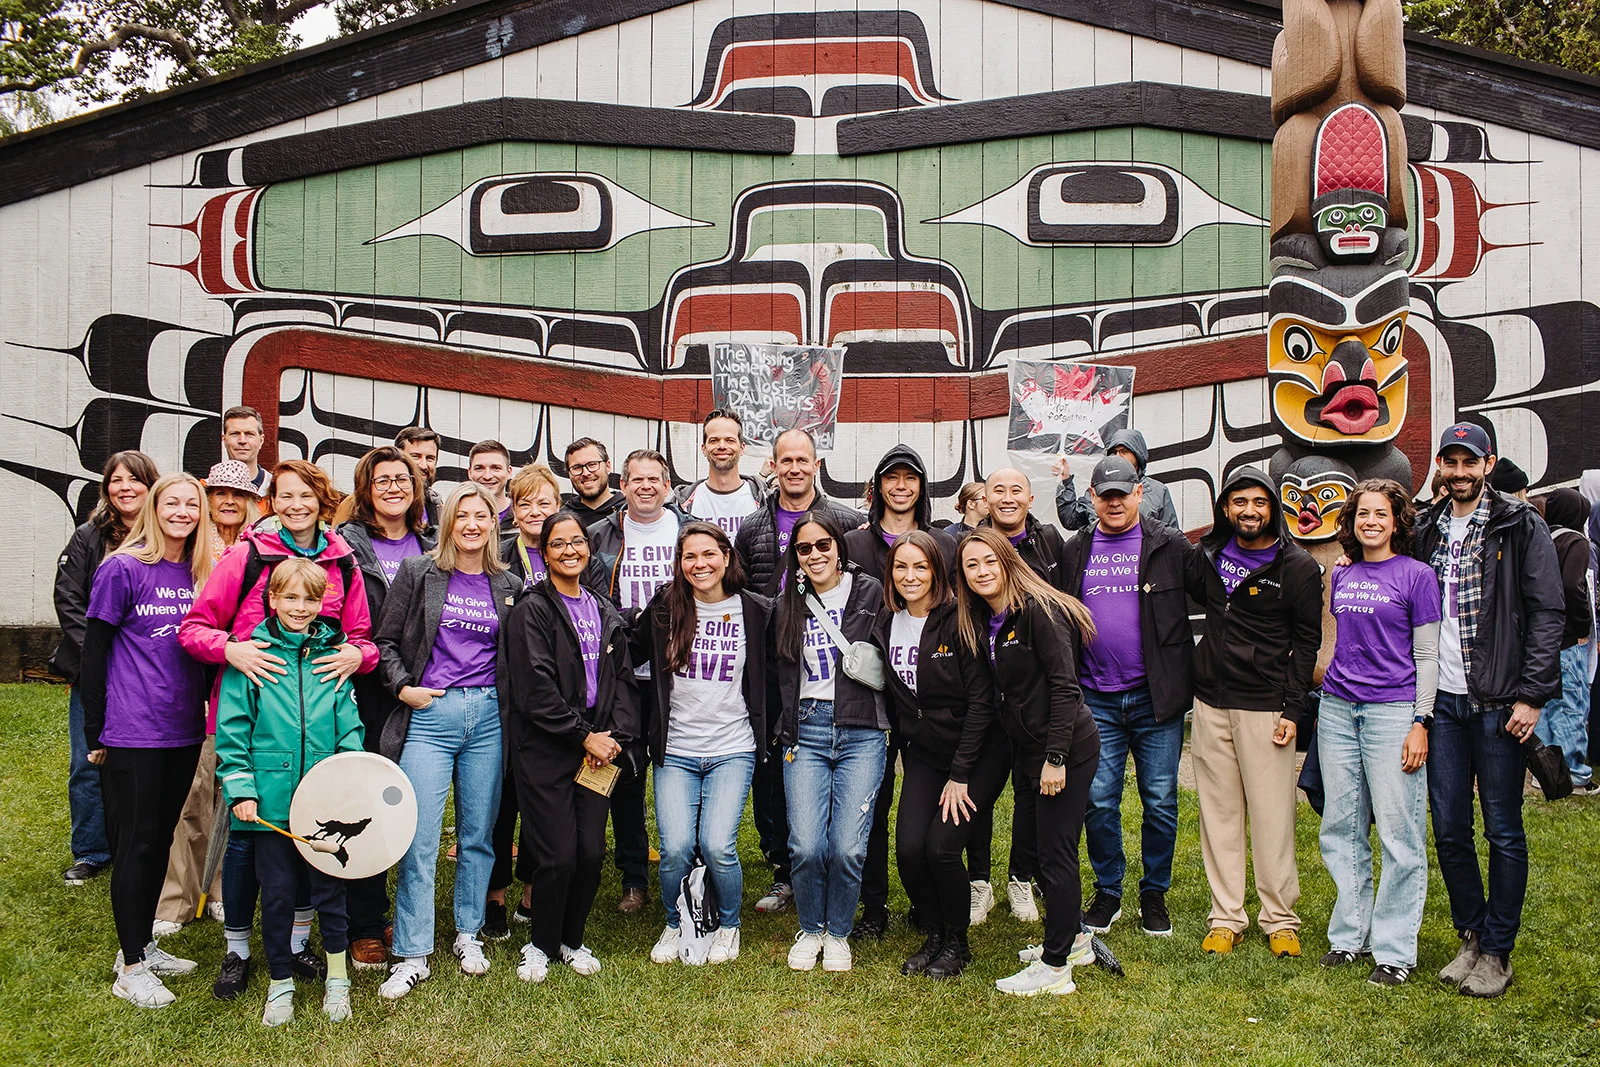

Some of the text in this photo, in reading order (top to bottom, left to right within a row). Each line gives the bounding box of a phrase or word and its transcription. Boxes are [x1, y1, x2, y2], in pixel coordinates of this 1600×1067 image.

[715, 344, 795, 373] The Missing
[715, 373, 750, 389] The
[735, 405, 767, 421] The
[718, 516, 744, 533] GIV
[643, 545, 673, 561] GIV
[1090, 553, 1138, 564] We Give
[382, 559, 400, 570] We
[622, 565, 659, 577] HERE
[1221, 559, 1236, 574] We
[1083, 567, 1108, 577] here
[1110, 566, 1130, 576] We
[1106, 584, 1139, 593] TELUS
[1347, 581, 1379, 591] We Give
[155, 587, 197, 600] We Giv
[1356, 591, 1370, 600] We
[1369, 592, 1390, 603] Live
[447, 594, 488, 608] We Give
[136, 604, 177, 617] Where
[442, 603, 464, 616] here
[465, 608, 482, 619] We
[1347, 605, 1375, 614] TELUS
[460, 621, 491, 634] TELUS
[705, 620, 740, 638] GIVE
[694, 637, 738, 652] ERE WE
